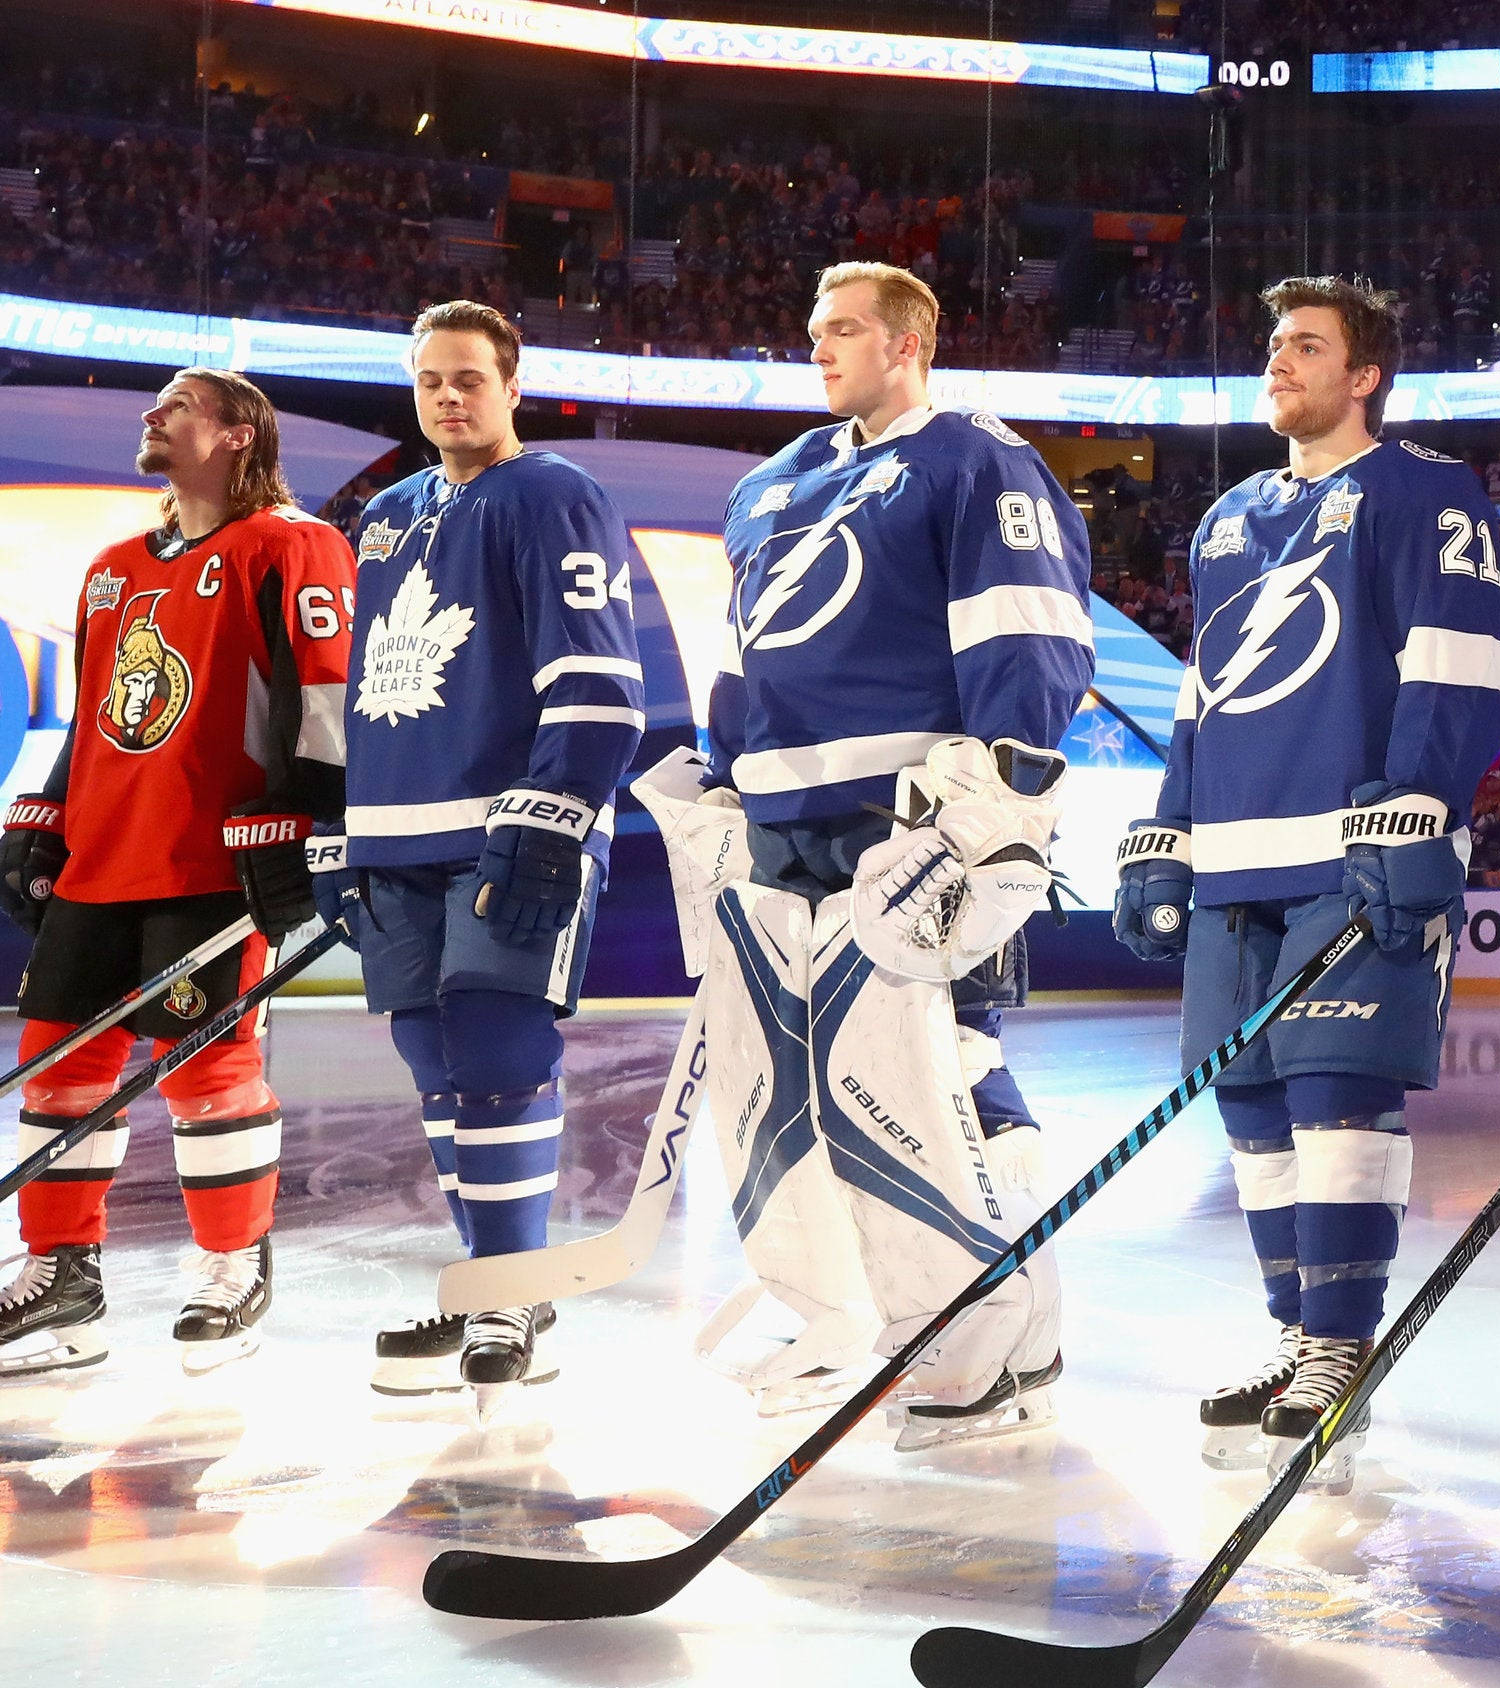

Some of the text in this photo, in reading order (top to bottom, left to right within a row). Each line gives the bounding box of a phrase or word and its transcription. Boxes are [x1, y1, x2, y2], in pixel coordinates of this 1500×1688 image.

[92, 323, 231, 354] DIVISION
[1438, 508, 1500, 586] 21
[196, 554, 223, 597] C
[561, 552, 634, 620] 34
[371, 634, 441, 663] TORONTO
[374, 658, 424, 675] MAPLE
[371, 676, 422, 694] LEAFS
[711, 828, 735, 882] VAPOR
[995, 879, 1045, 892] VAPOR
[1280, 1000, 1381, 1021] CCM
[640, 1014, 706, 1193] VAPO
[735, 1071, 767, 1151] BAUER
[840, 1074, 925, 1156] BAUER
[951, 1092, 1004, 1221] BAUER
